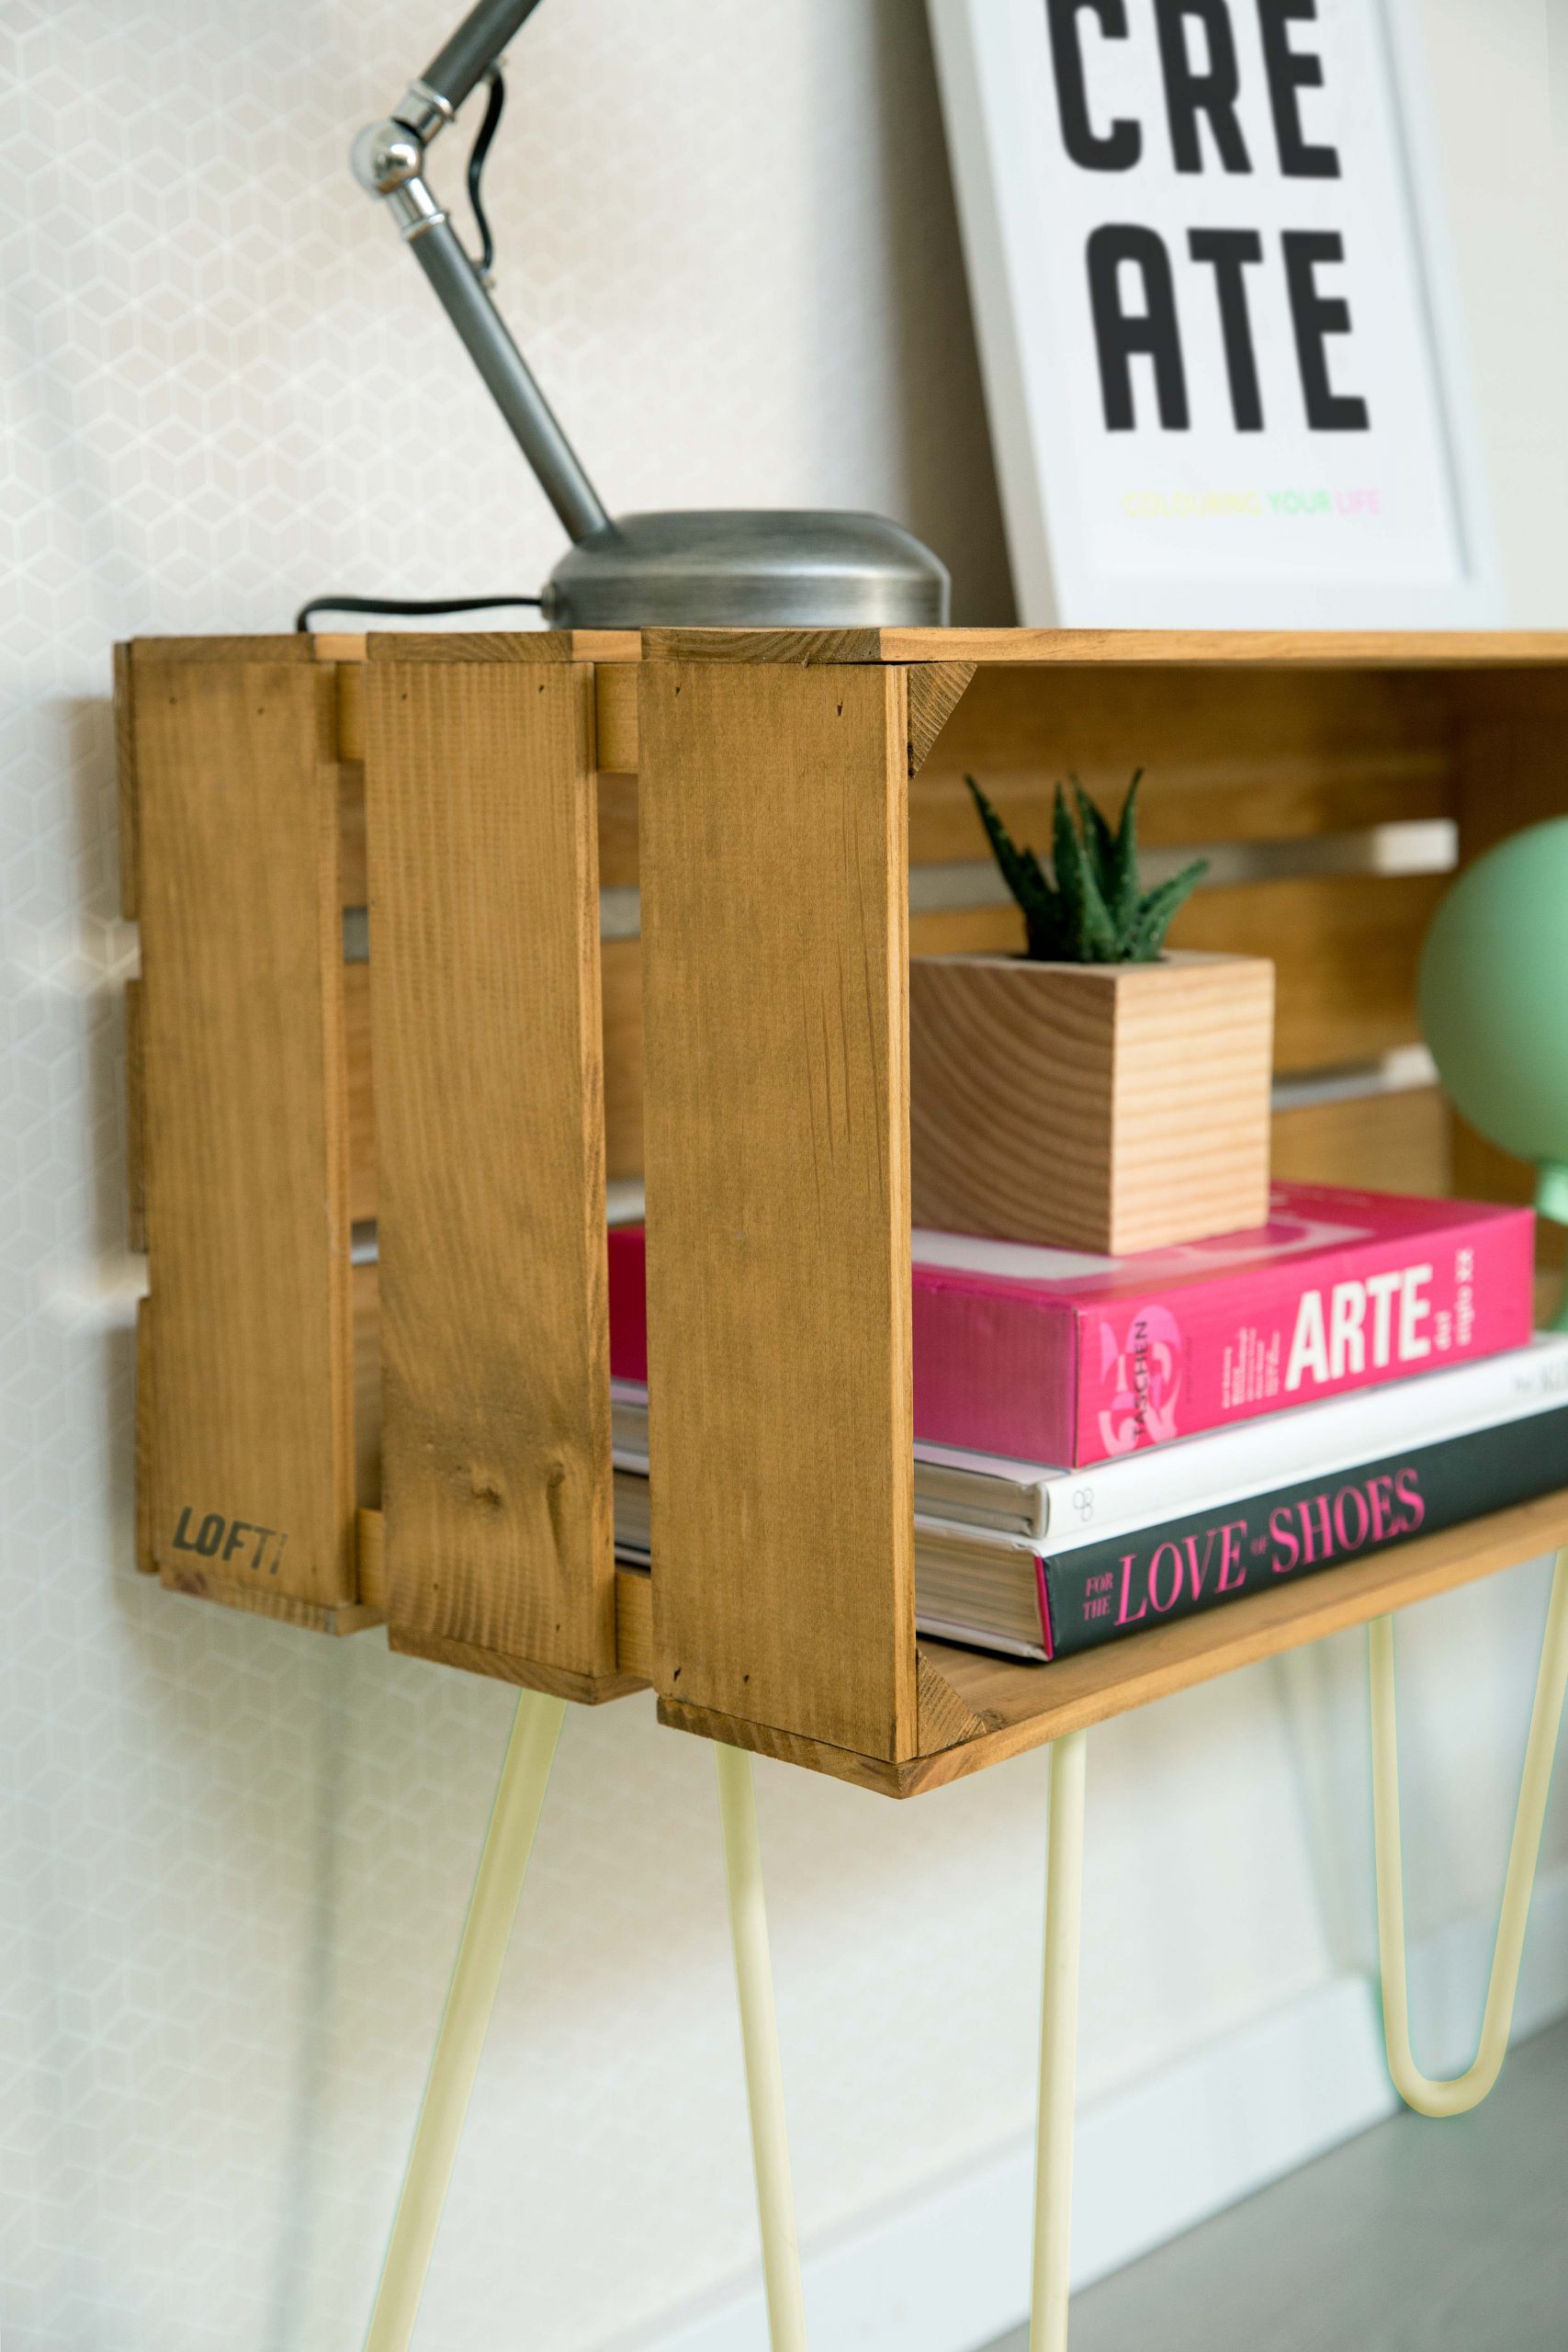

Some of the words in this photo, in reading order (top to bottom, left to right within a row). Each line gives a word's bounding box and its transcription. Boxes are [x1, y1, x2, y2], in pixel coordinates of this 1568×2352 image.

[1045, 0, 1341, 178] CRE
[1086, 223, 1370, 432] ATE
[1267, 489, 1332, 514] YOUR
[1336, 488, 1380, 514] LIFE
[1134, 1320, 1146, 1440] TASCHEN
[1285, 1264, 1434, 1392] ARTE
[1083, 1595, 1111, 1621] THE
[1087, 1572, 1113, 1597] FOR
[1114, 1521, 1247, 1626] LOVE
[1269, 1469, 1425, 1573] SHOES
